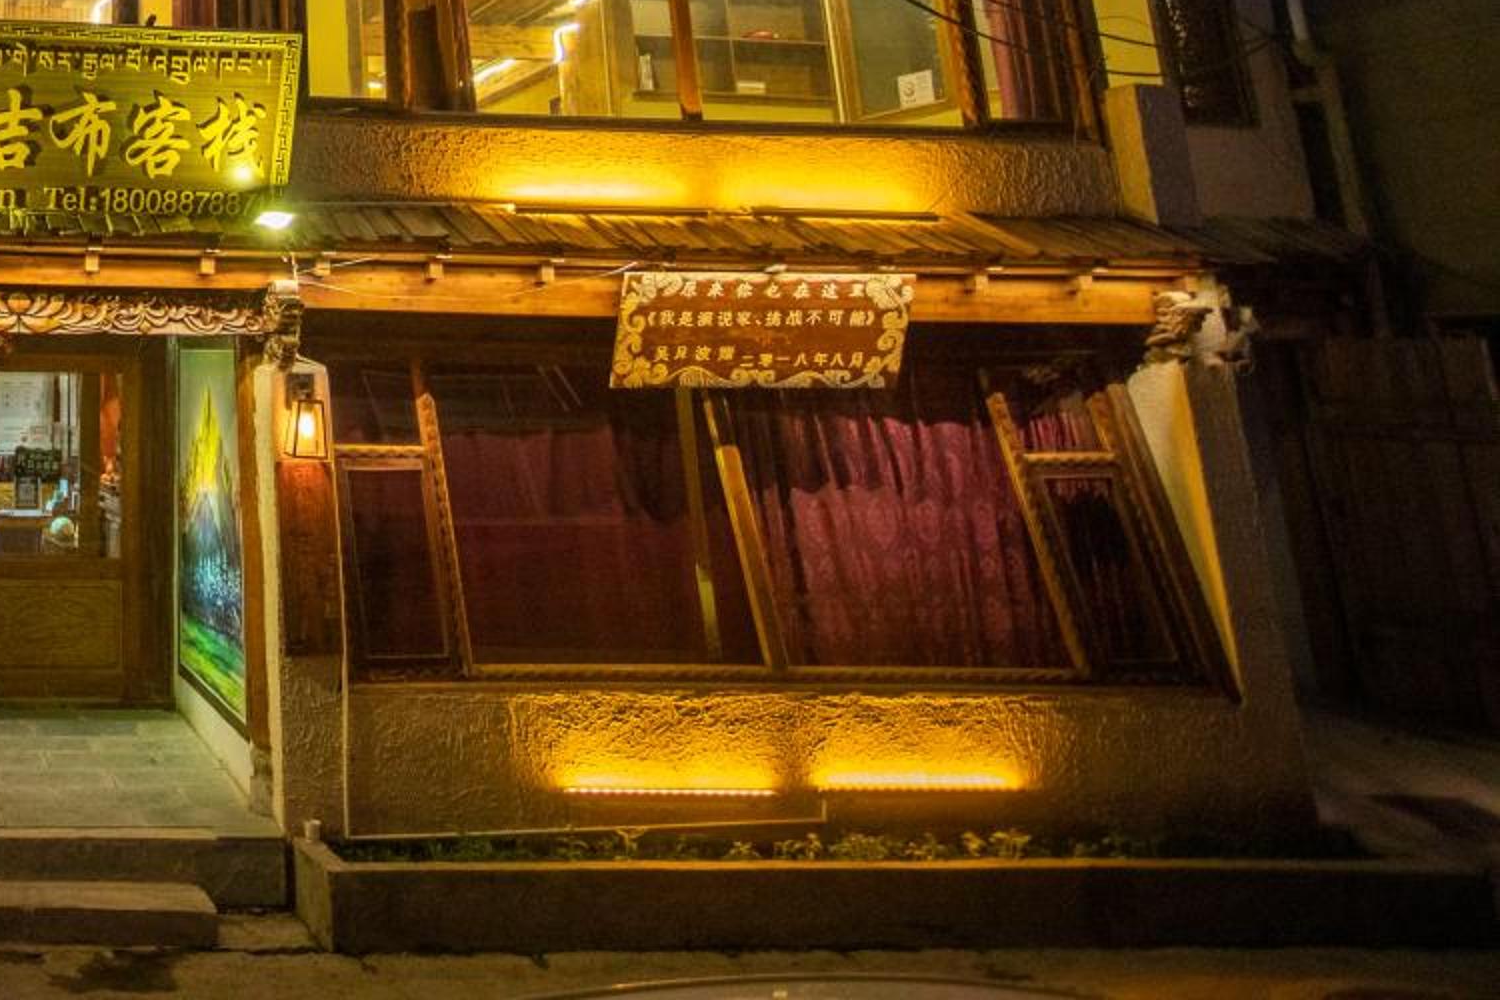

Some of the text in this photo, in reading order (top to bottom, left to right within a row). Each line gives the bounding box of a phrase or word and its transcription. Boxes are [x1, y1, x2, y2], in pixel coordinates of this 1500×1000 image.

[679, 281, 866, 299] 原来你也在这里
[739, 351, 864, 369] 二零一八年八月
